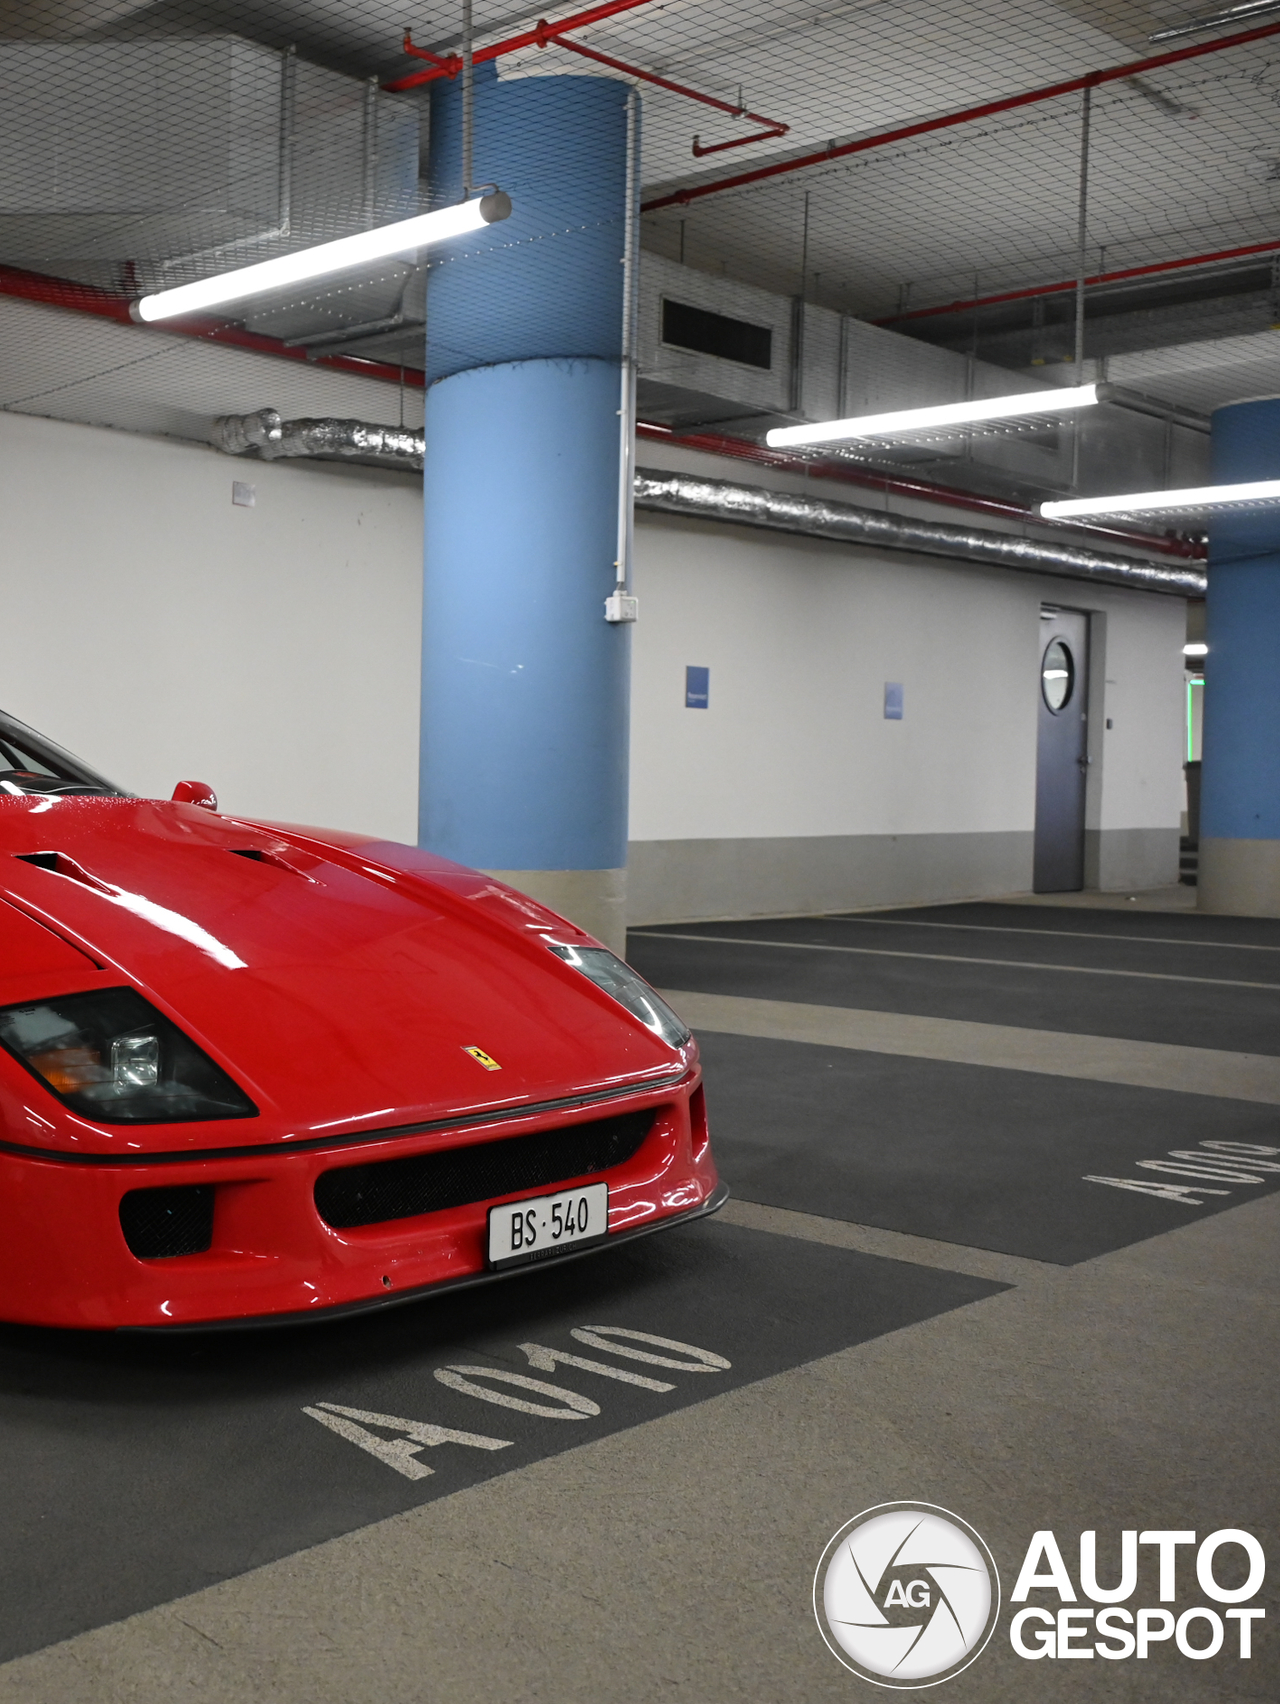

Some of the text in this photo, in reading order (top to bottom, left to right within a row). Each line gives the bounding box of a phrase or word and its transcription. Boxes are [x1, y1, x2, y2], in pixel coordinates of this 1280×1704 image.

[1081, 1175, 1232, 1205] A
[300, 1325, 732, 1481] A 010
